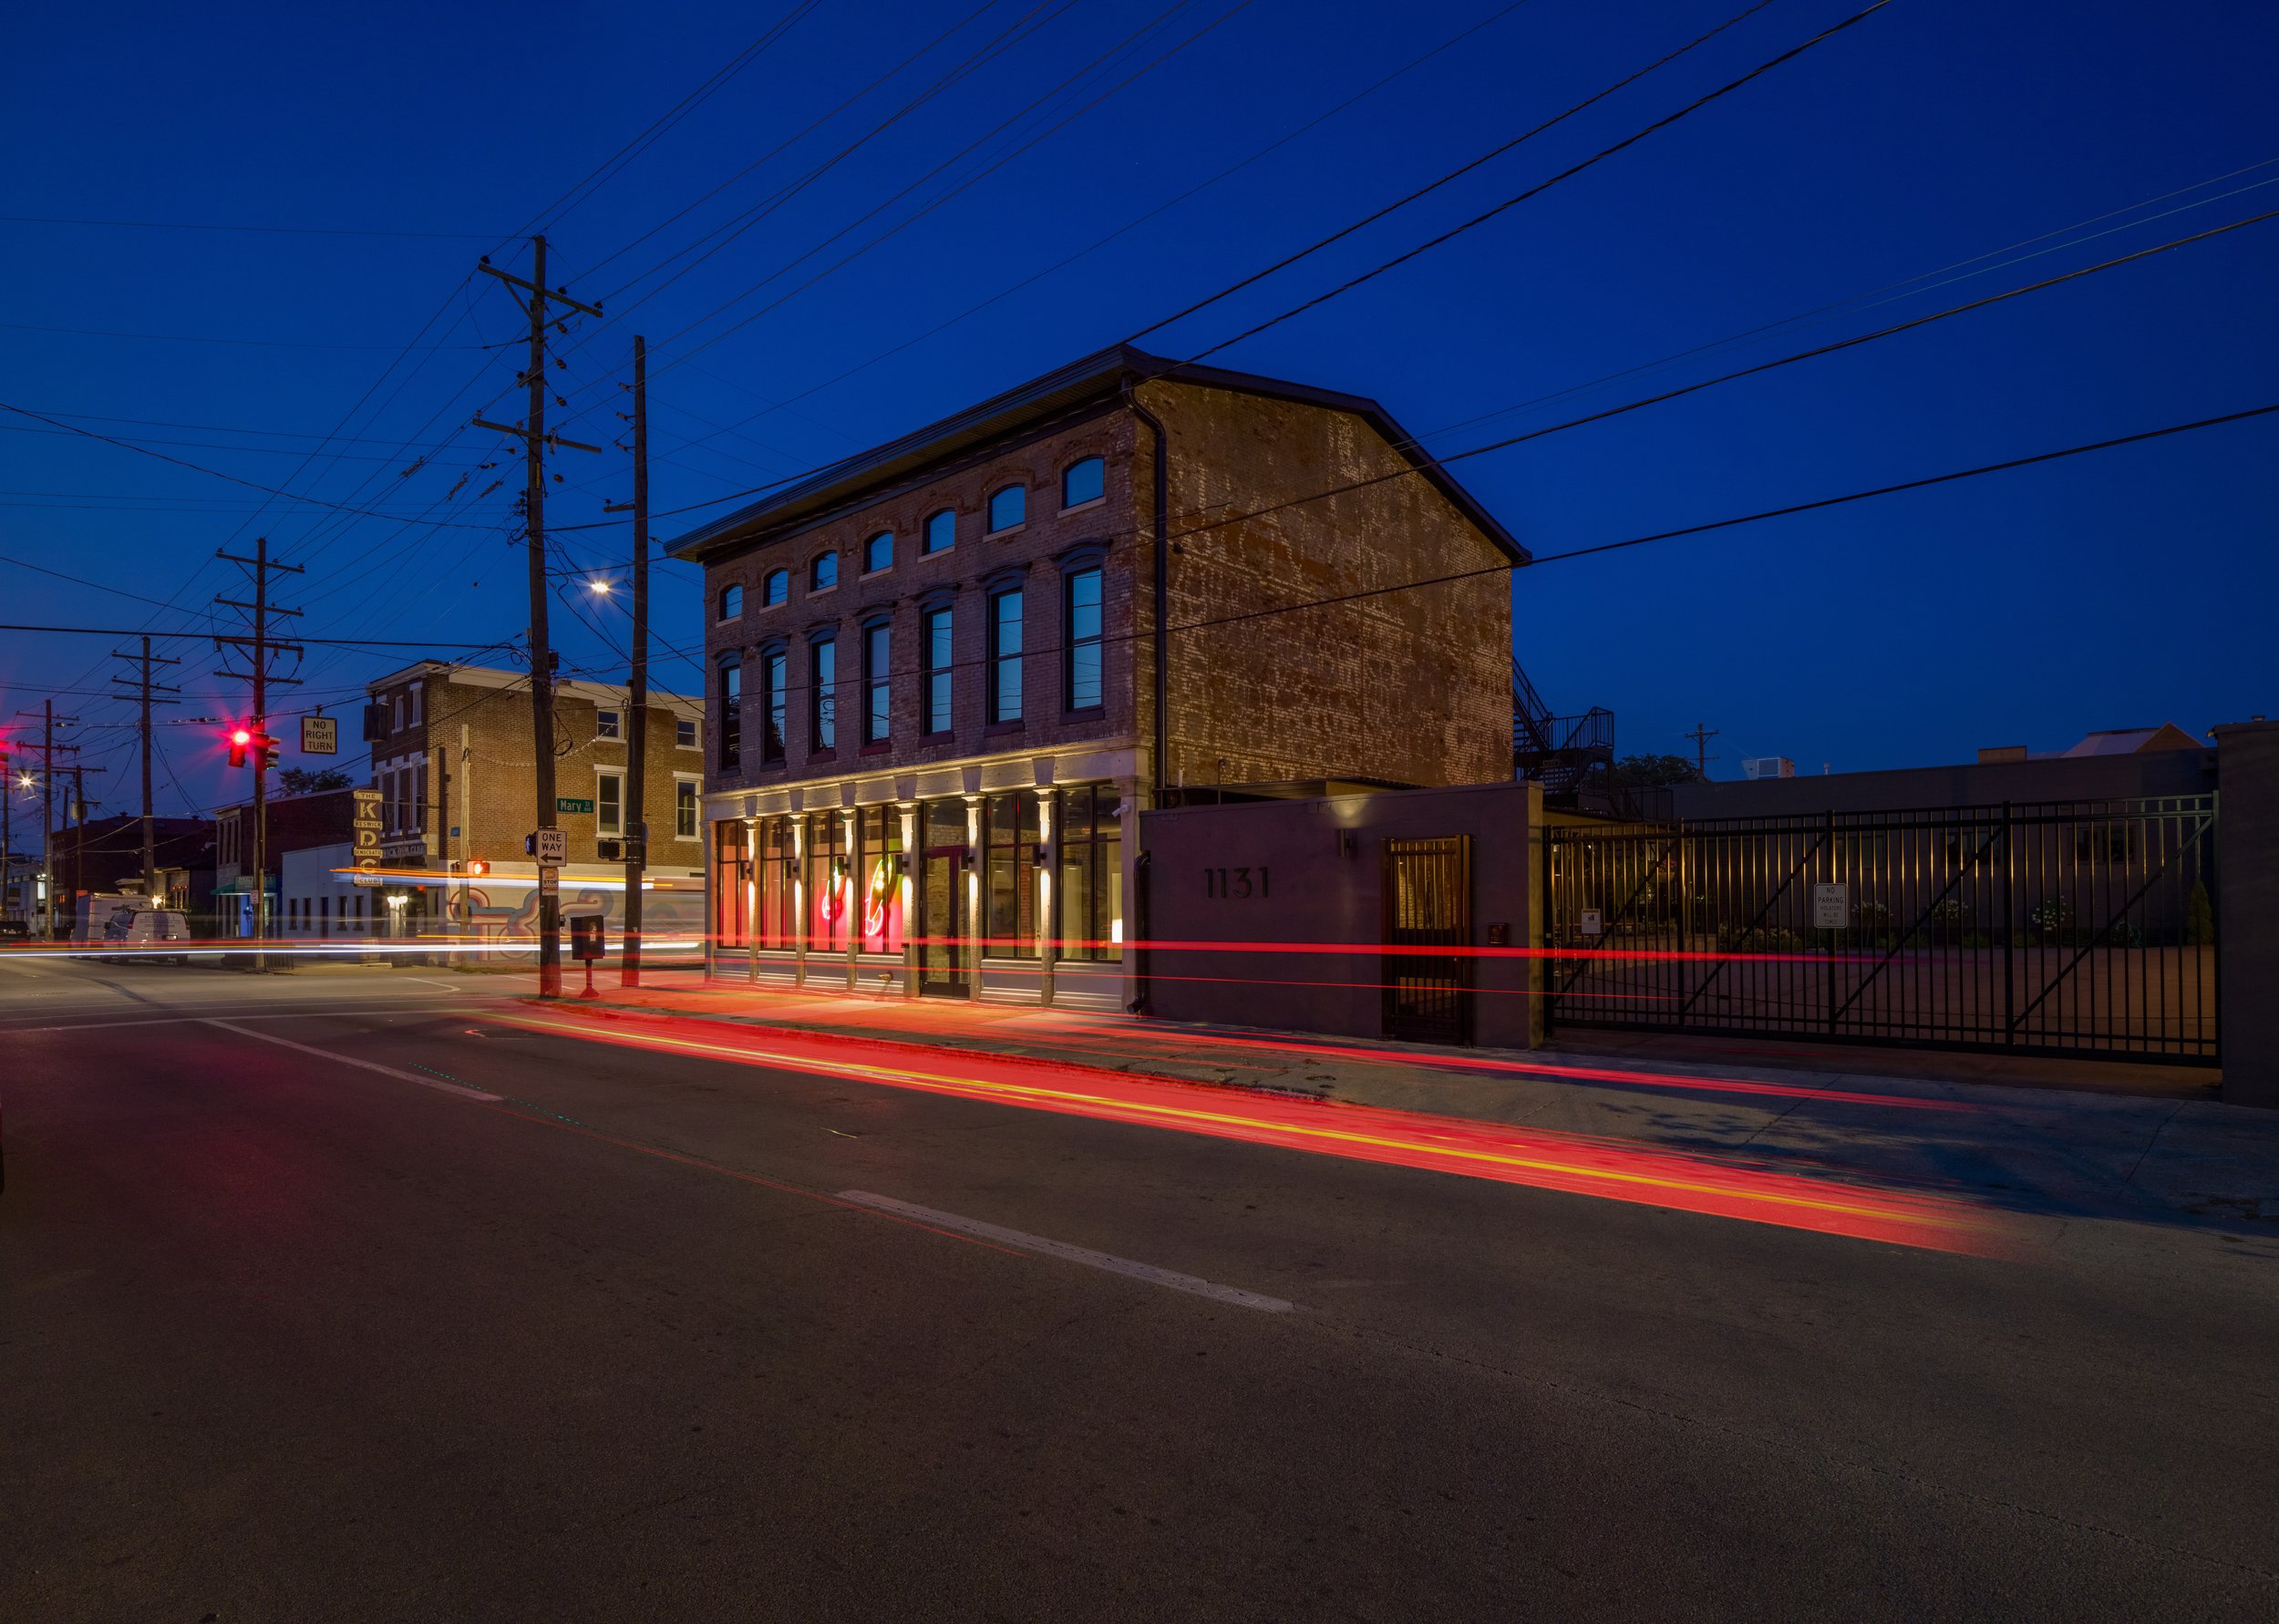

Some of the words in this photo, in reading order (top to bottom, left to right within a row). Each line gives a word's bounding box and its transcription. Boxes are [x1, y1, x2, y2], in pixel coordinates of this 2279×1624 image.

[314, 721, 326, 729] NO
[306, 730, 334, 740] RIGHT
[307, 741, 333, 750] TURN
[560, 799, 582, 814] Mary
[542, 833, 562, 841] ONE
[541, 843, 562, 851] WAY
[1204, 867, 1268, 899] 1131
